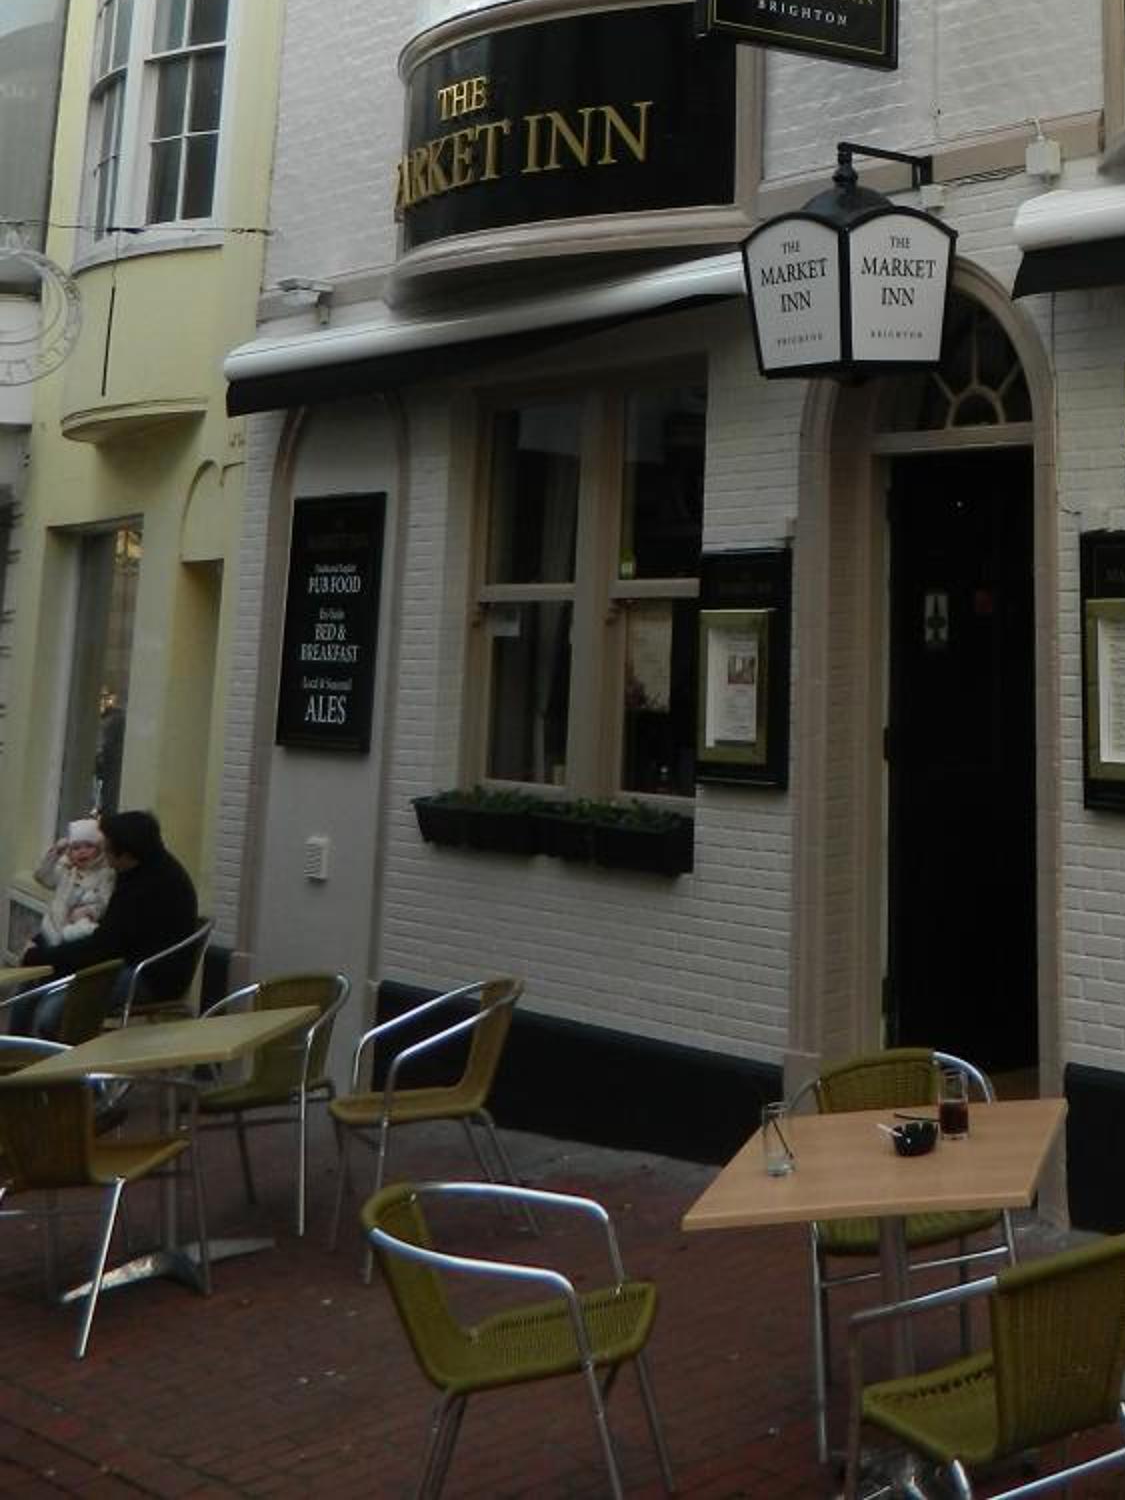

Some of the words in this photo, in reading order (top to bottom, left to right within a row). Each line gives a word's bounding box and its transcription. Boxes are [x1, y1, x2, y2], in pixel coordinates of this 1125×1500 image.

[438, 76, 488, 120] THE
[394, 118, 512, 208] ARKET
[521, 101, 653, 174] INN
[781, 240, 801, 255] THE
[890, 236, 911, 250] THE
[761, 257, 829, 287] MARKET
[861, 256, 937, 279] MARKET
[781, 290, 811, 313] INN
[881, 287, 915, 307] INN
[309, 575, 329, 594] PUB
[330, 575, 361, 593] FOOD
[314, 622, 336, 641] BED
[301, 643, 360, 663] BREAKFAST
[304, 694, 346, 725] ALES
